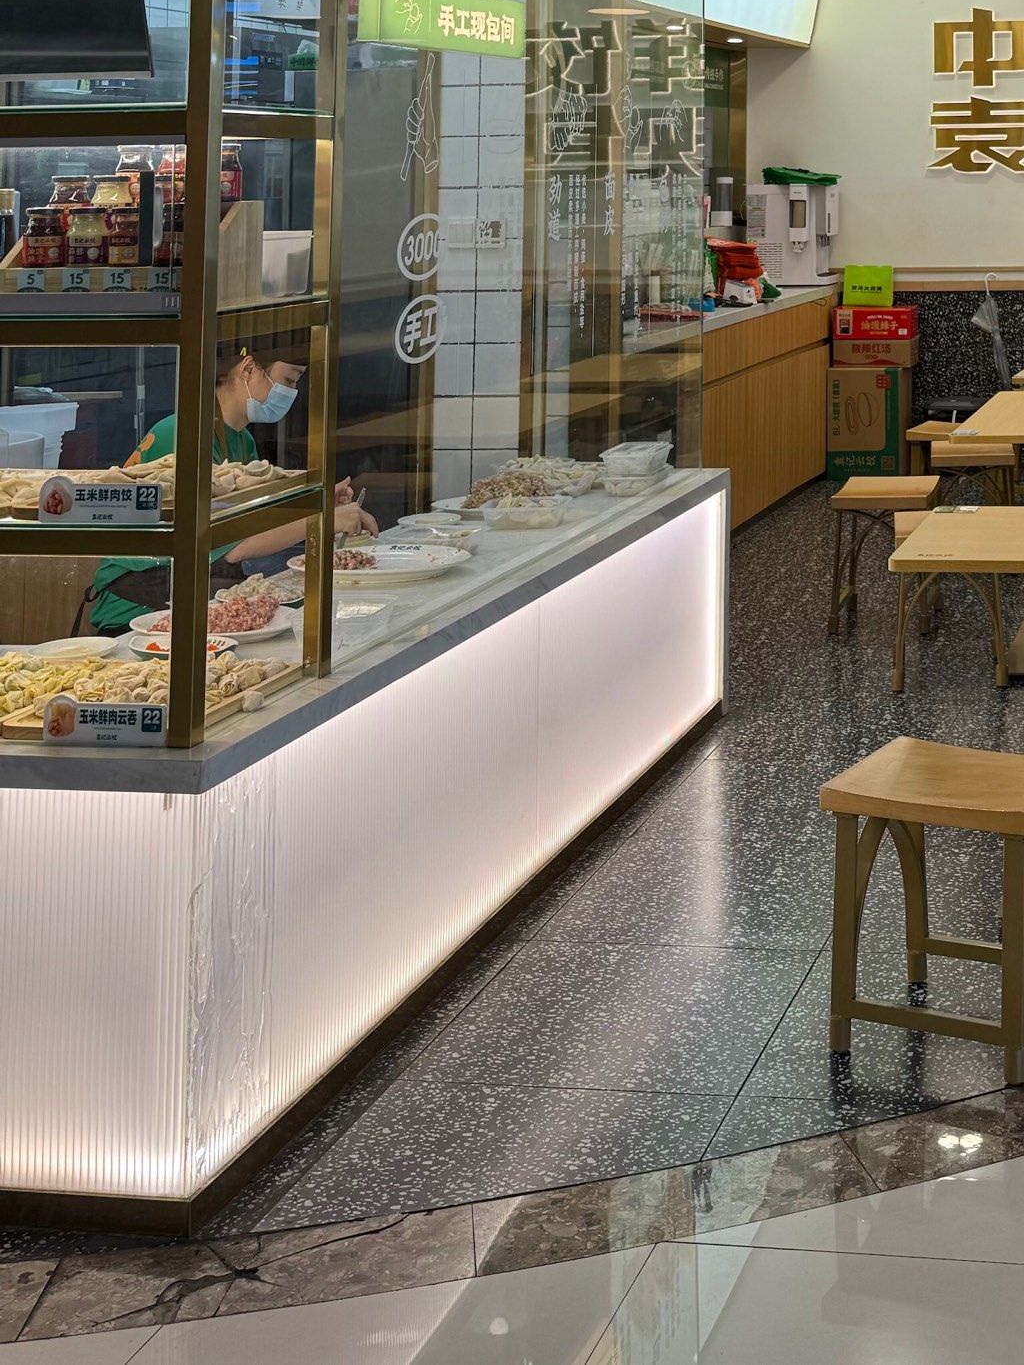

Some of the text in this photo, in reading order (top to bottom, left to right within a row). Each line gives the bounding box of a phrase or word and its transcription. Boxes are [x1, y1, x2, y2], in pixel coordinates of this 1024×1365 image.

[438, 4, 515, 45] 手工现包间
[27, 273, 35, 285] 5
[69, 273, 83, 285] 15
[110, 273, 124, 285] 15
[154, 273, 169, 285] 15
[403, 306, 439, 353] 手工
[75, 487, 156, 501] 玉米鲜肉饺 22
[79, 709, 160, 725] 玉米鲜肉云吞 22
